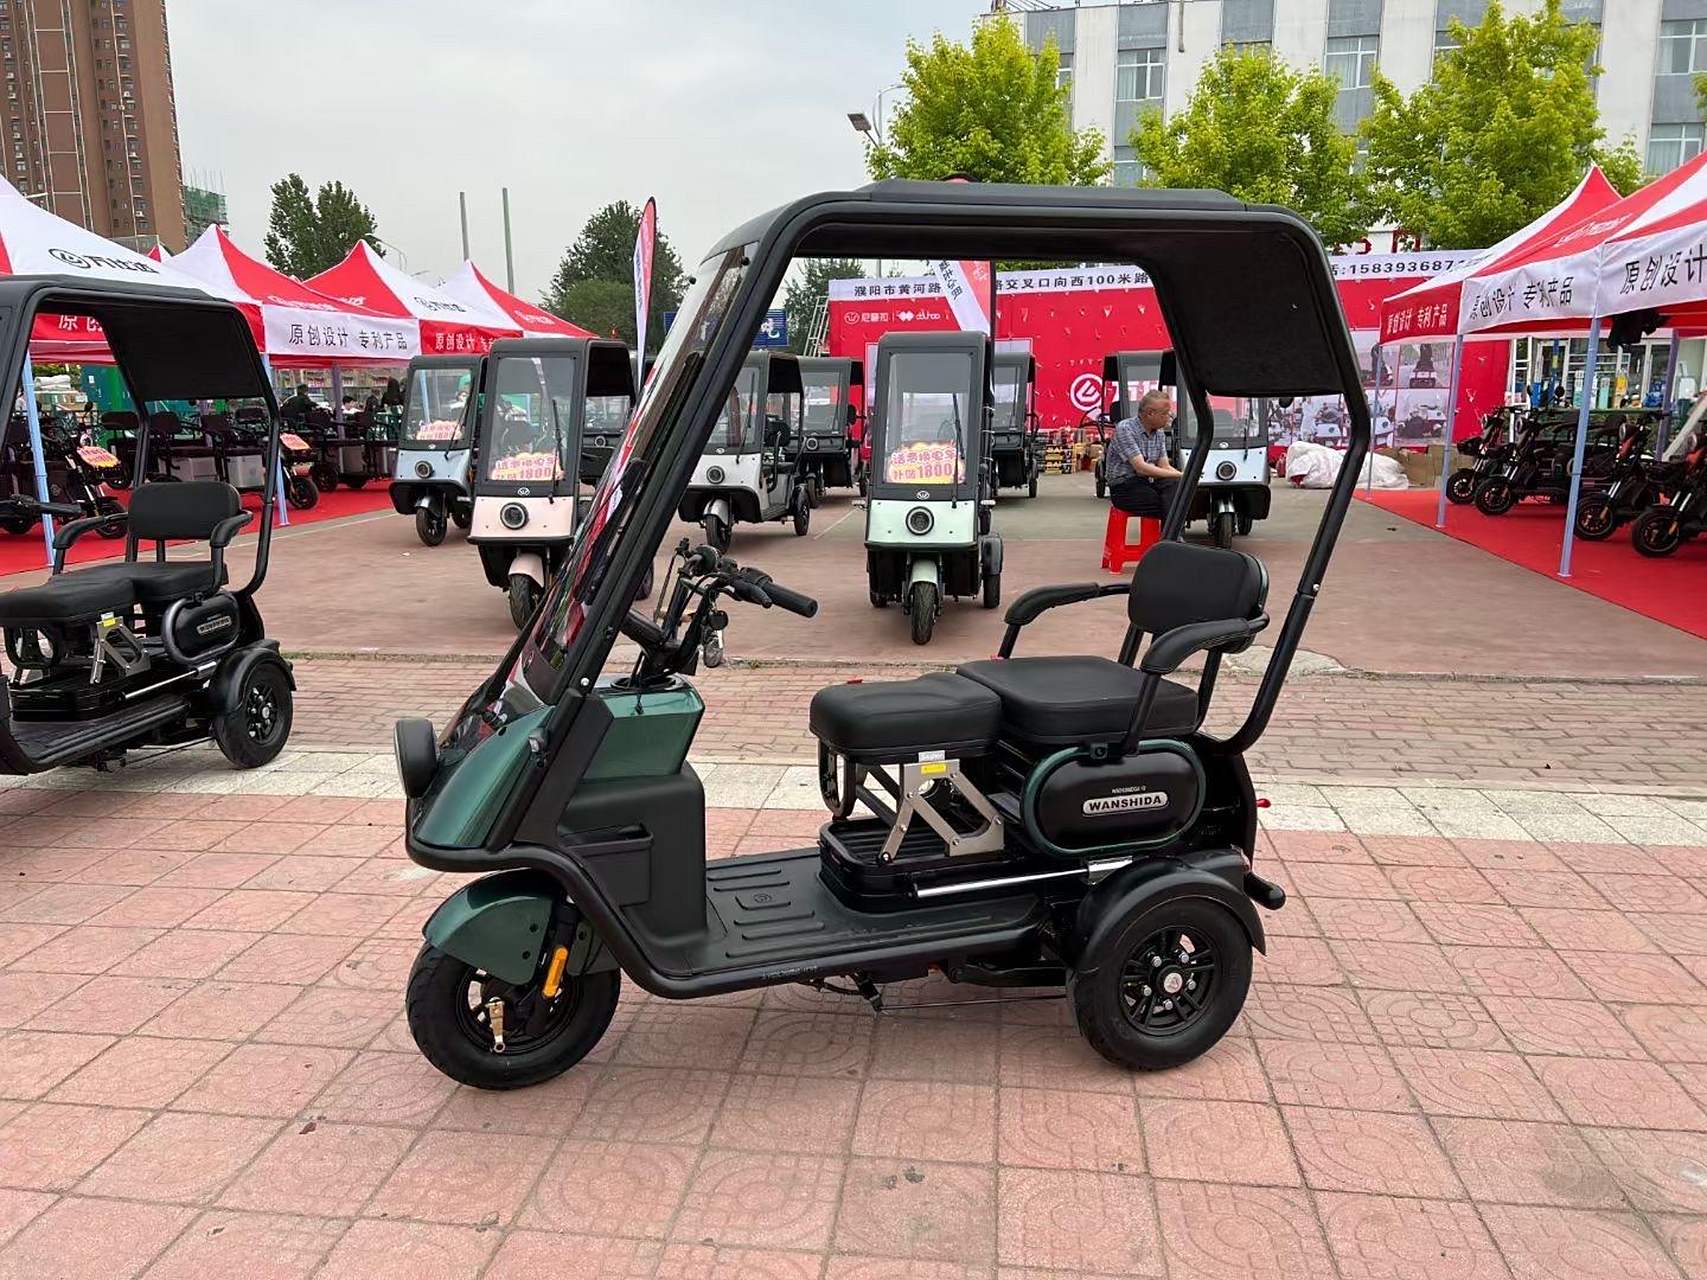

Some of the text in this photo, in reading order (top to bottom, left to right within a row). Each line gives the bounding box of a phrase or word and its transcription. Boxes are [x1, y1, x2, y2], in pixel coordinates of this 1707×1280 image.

[1619, 243, 1707, 295] 原创设计
[854, 282, 942, 297] 濮阳市黄河路
[1522, 275, 1575, 310] 专利产品
[1416, 303, 1448, 329] 专利产品
[288, 323, 408, 350] 原创设计 专利产品
[434, 332, 475, 351] 原创设计
[1088, 795, 1162, 812] WANSHIDA
